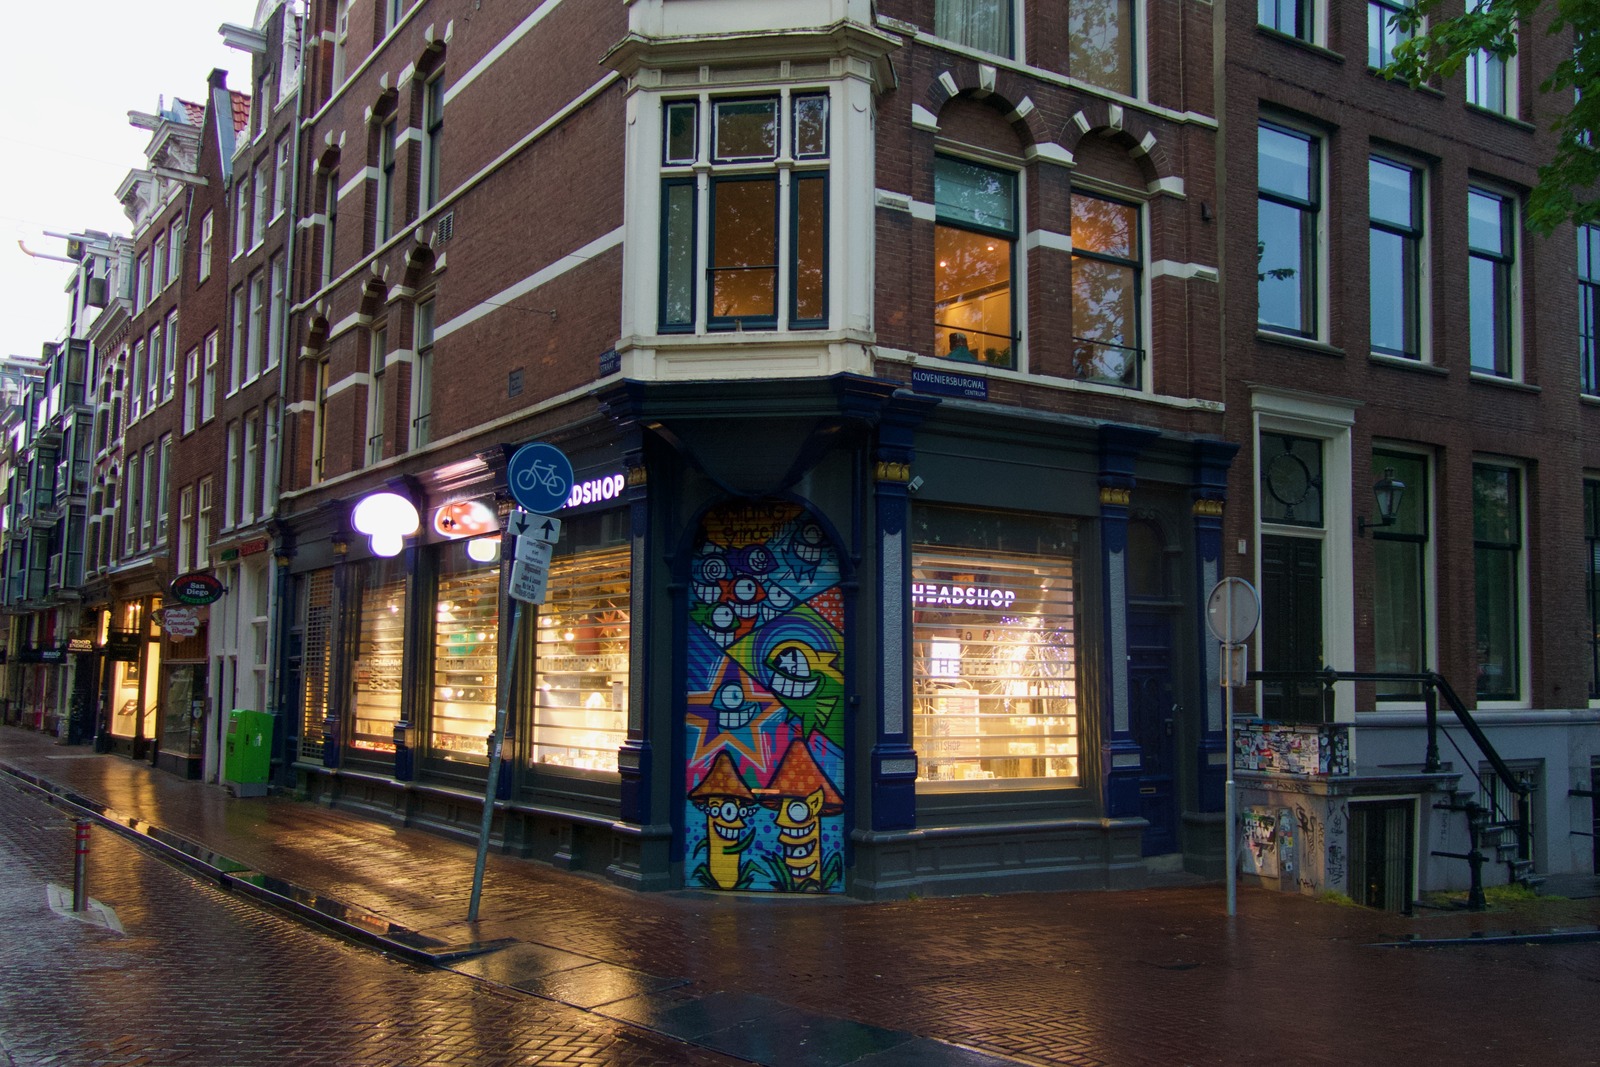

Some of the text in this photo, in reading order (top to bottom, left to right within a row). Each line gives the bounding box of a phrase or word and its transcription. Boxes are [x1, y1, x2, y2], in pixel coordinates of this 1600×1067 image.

[913, 371, 985, 390] KLOVENIERSBURGWAL
[964, 389, 986, 397] CENTRUM
[187, 588, 209, 597] Diego
[912, 584, 1016, 607] HEADSHOP
